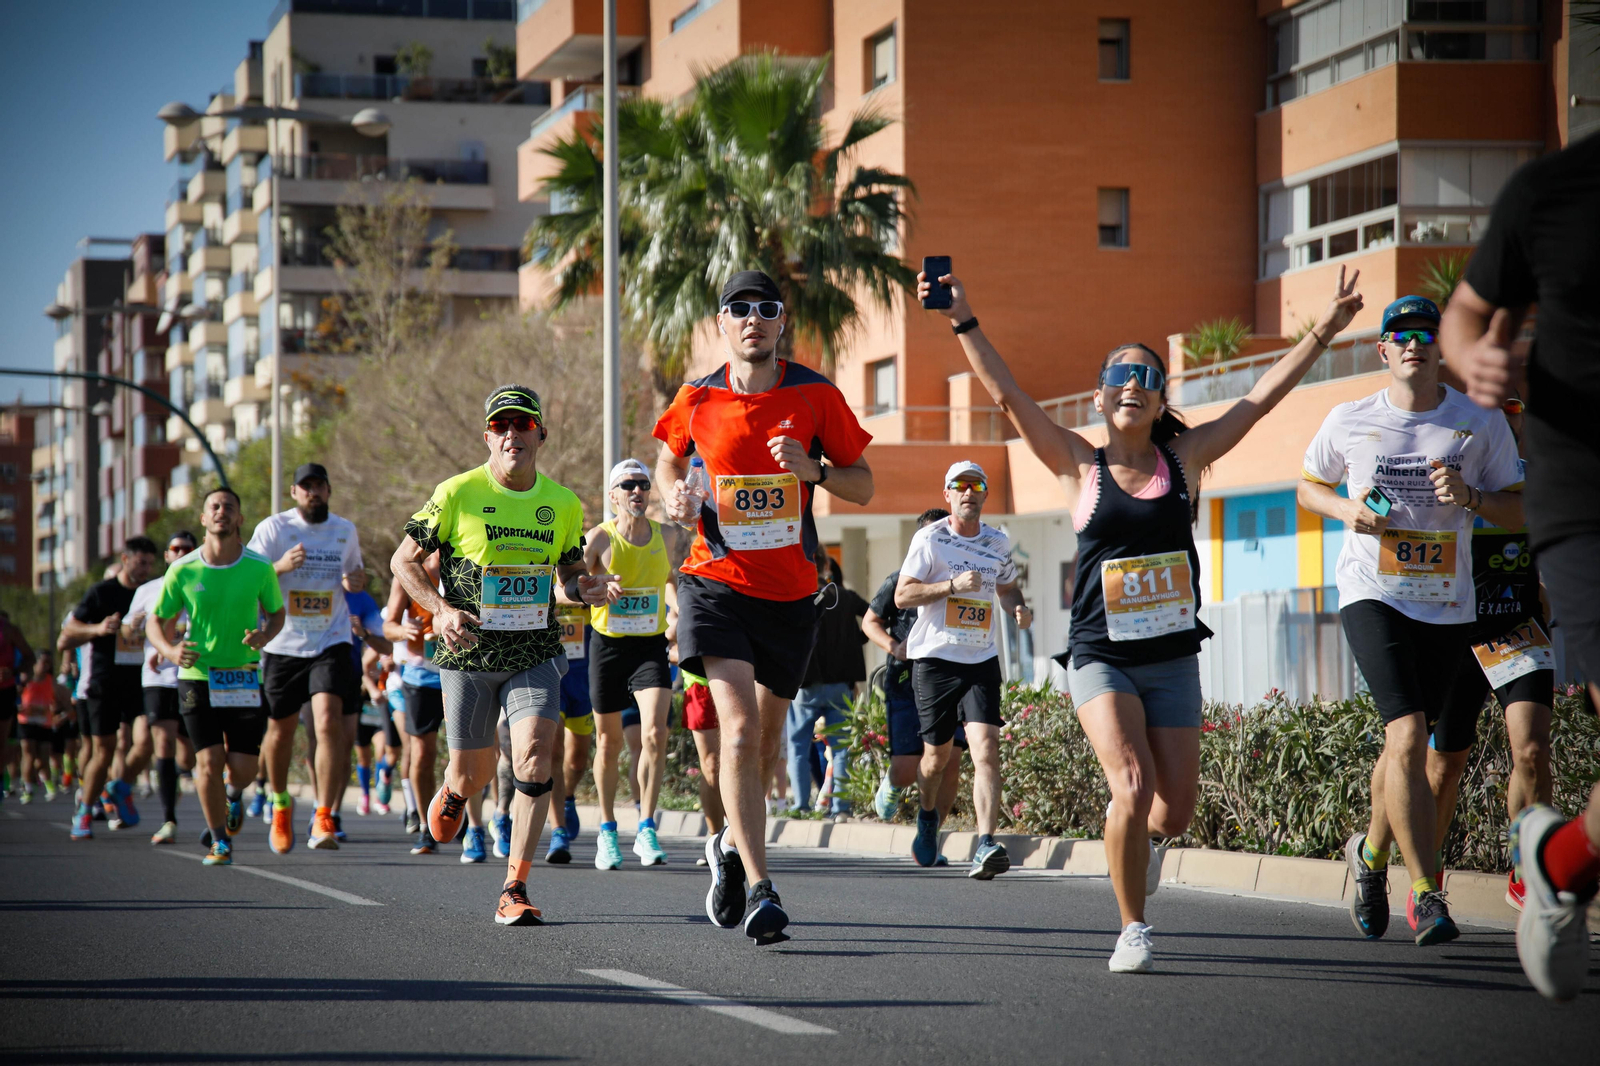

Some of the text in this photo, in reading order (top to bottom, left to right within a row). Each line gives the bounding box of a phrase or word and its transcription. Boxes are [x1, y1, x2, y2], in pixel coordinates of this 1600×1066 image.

[1375, 453, 1465, 467] Medio Matón
[1375, 464, 1427, 478] Almería
[1375, 478, 1404, 487] RAMÓN
[735, 487, 787, 512] 893
[484, 523, 555, 546] DEPORTEMANIA
[323, 555, 342, 563] 2024
[1395, 541, 1444, 565] 812
[947, 561, 966, 572] San
[966, 562, 997, 576] Silvestre
[497, 576, 540, 597] 203
[1122, 566, 1173, 598] 811
[293, 597, 330, 610] 1229
[619, 596, 650, 610] 378
[1119, 591, 1180, 605] MANUELAYHUGO
[957, 605, 986, 622] 738
[214, 670, 255, 685] 2093
